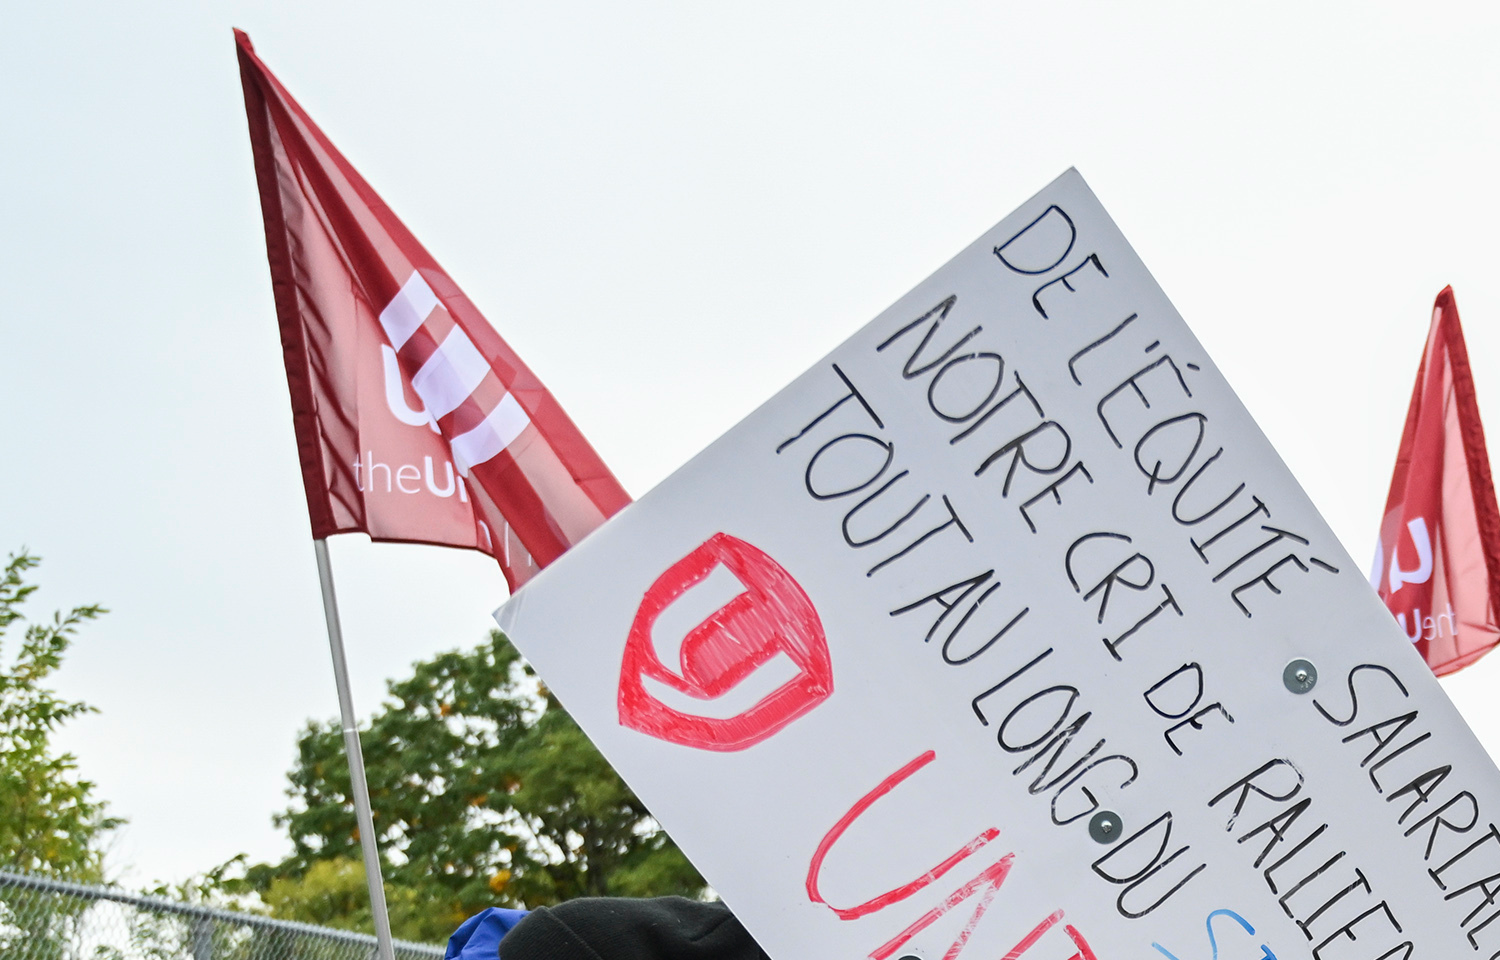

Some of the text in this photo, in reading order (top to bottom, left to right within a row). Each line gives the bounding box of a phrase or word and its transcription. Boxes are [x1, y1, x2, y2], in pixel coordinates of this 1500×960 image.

[775, 363, 974, 577] TOUT
[889, 569, 1030, 666] AU
[971, 647, 1139, 826] LONG
[1091, 811, 1206, 919] DU
[876, 294, 1094, 534] NOTRE
[1065, 532, 1184, 662] CRI
[1143, 662, 1235, 756] DE
[994, 205, 1109, 319] DE
[1069, 313, 1339, 619] L'ÉQUITÉ
